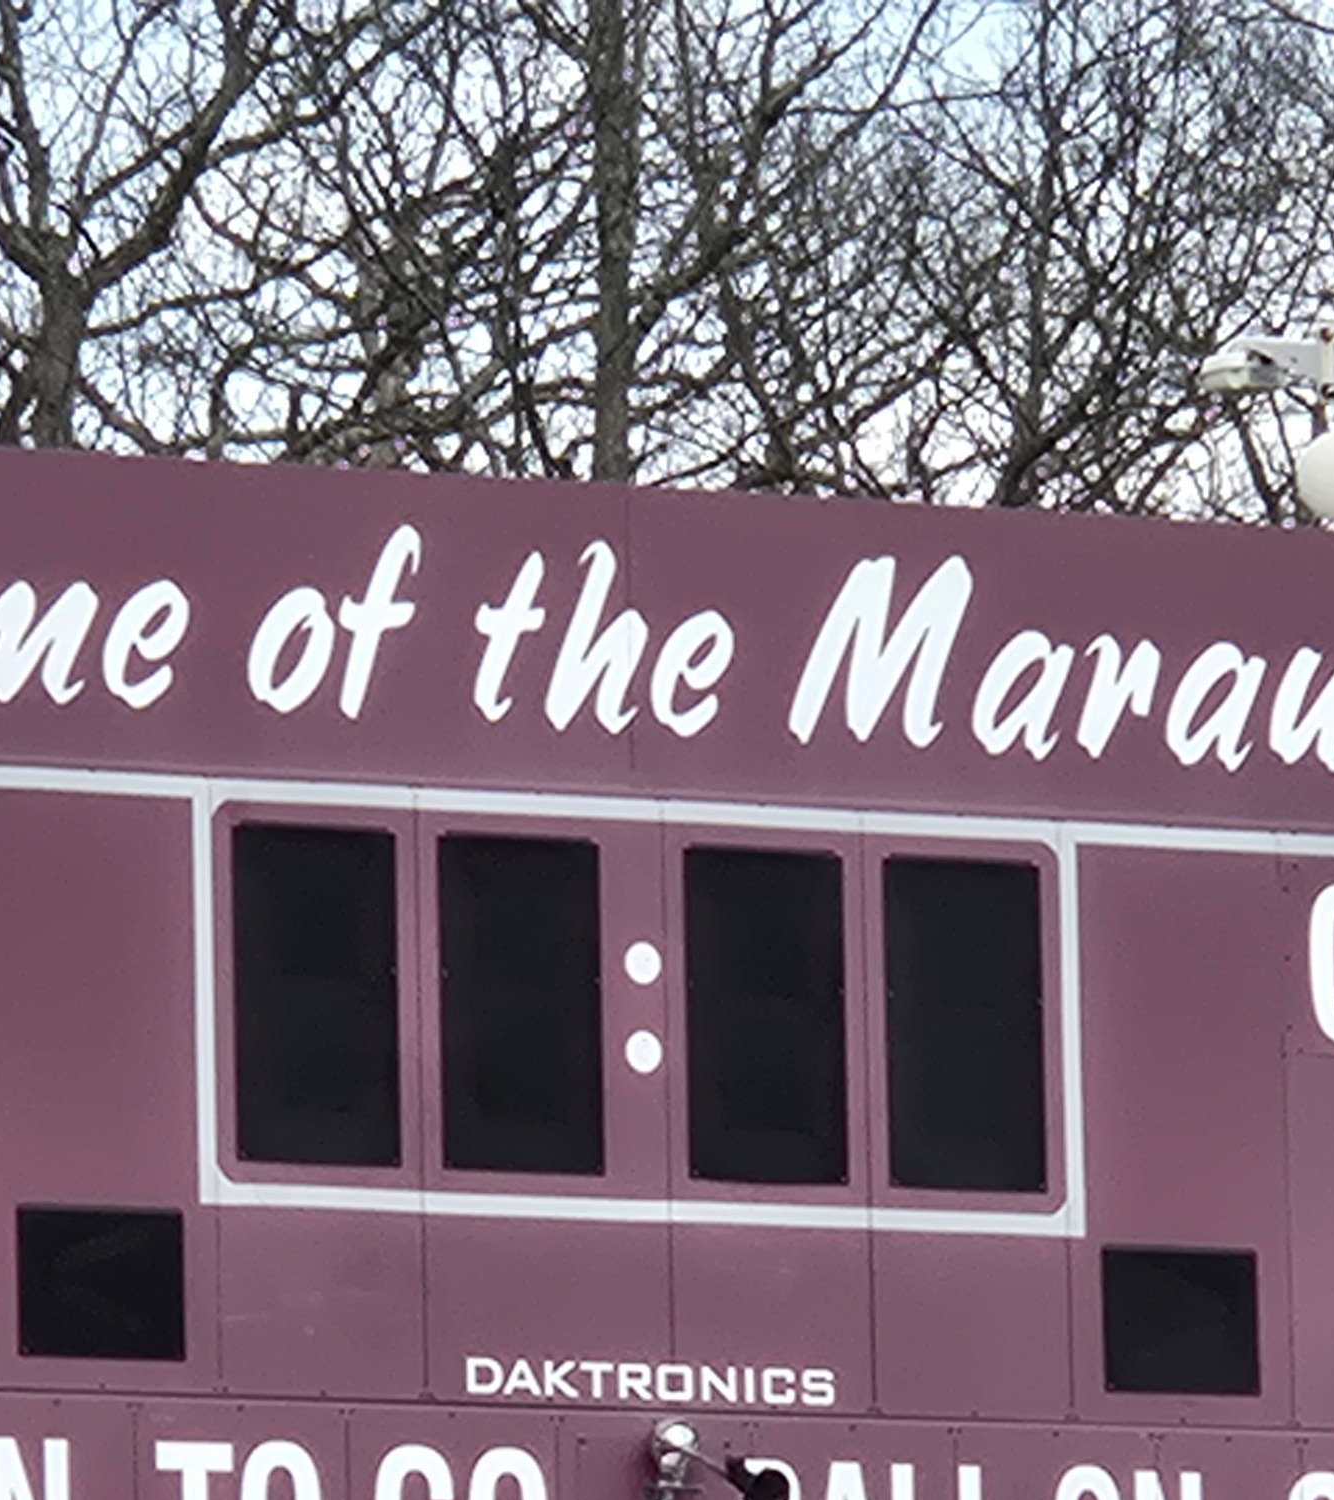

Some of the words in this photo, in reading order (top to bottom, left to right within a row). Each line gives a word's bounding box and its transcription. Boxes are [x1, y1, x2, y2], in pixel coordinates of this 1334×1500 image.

[247, 524, 422, 719] of
[473, 540, 735, 738] the
[465, 1355, 836, 1408] DAKTRONICS
